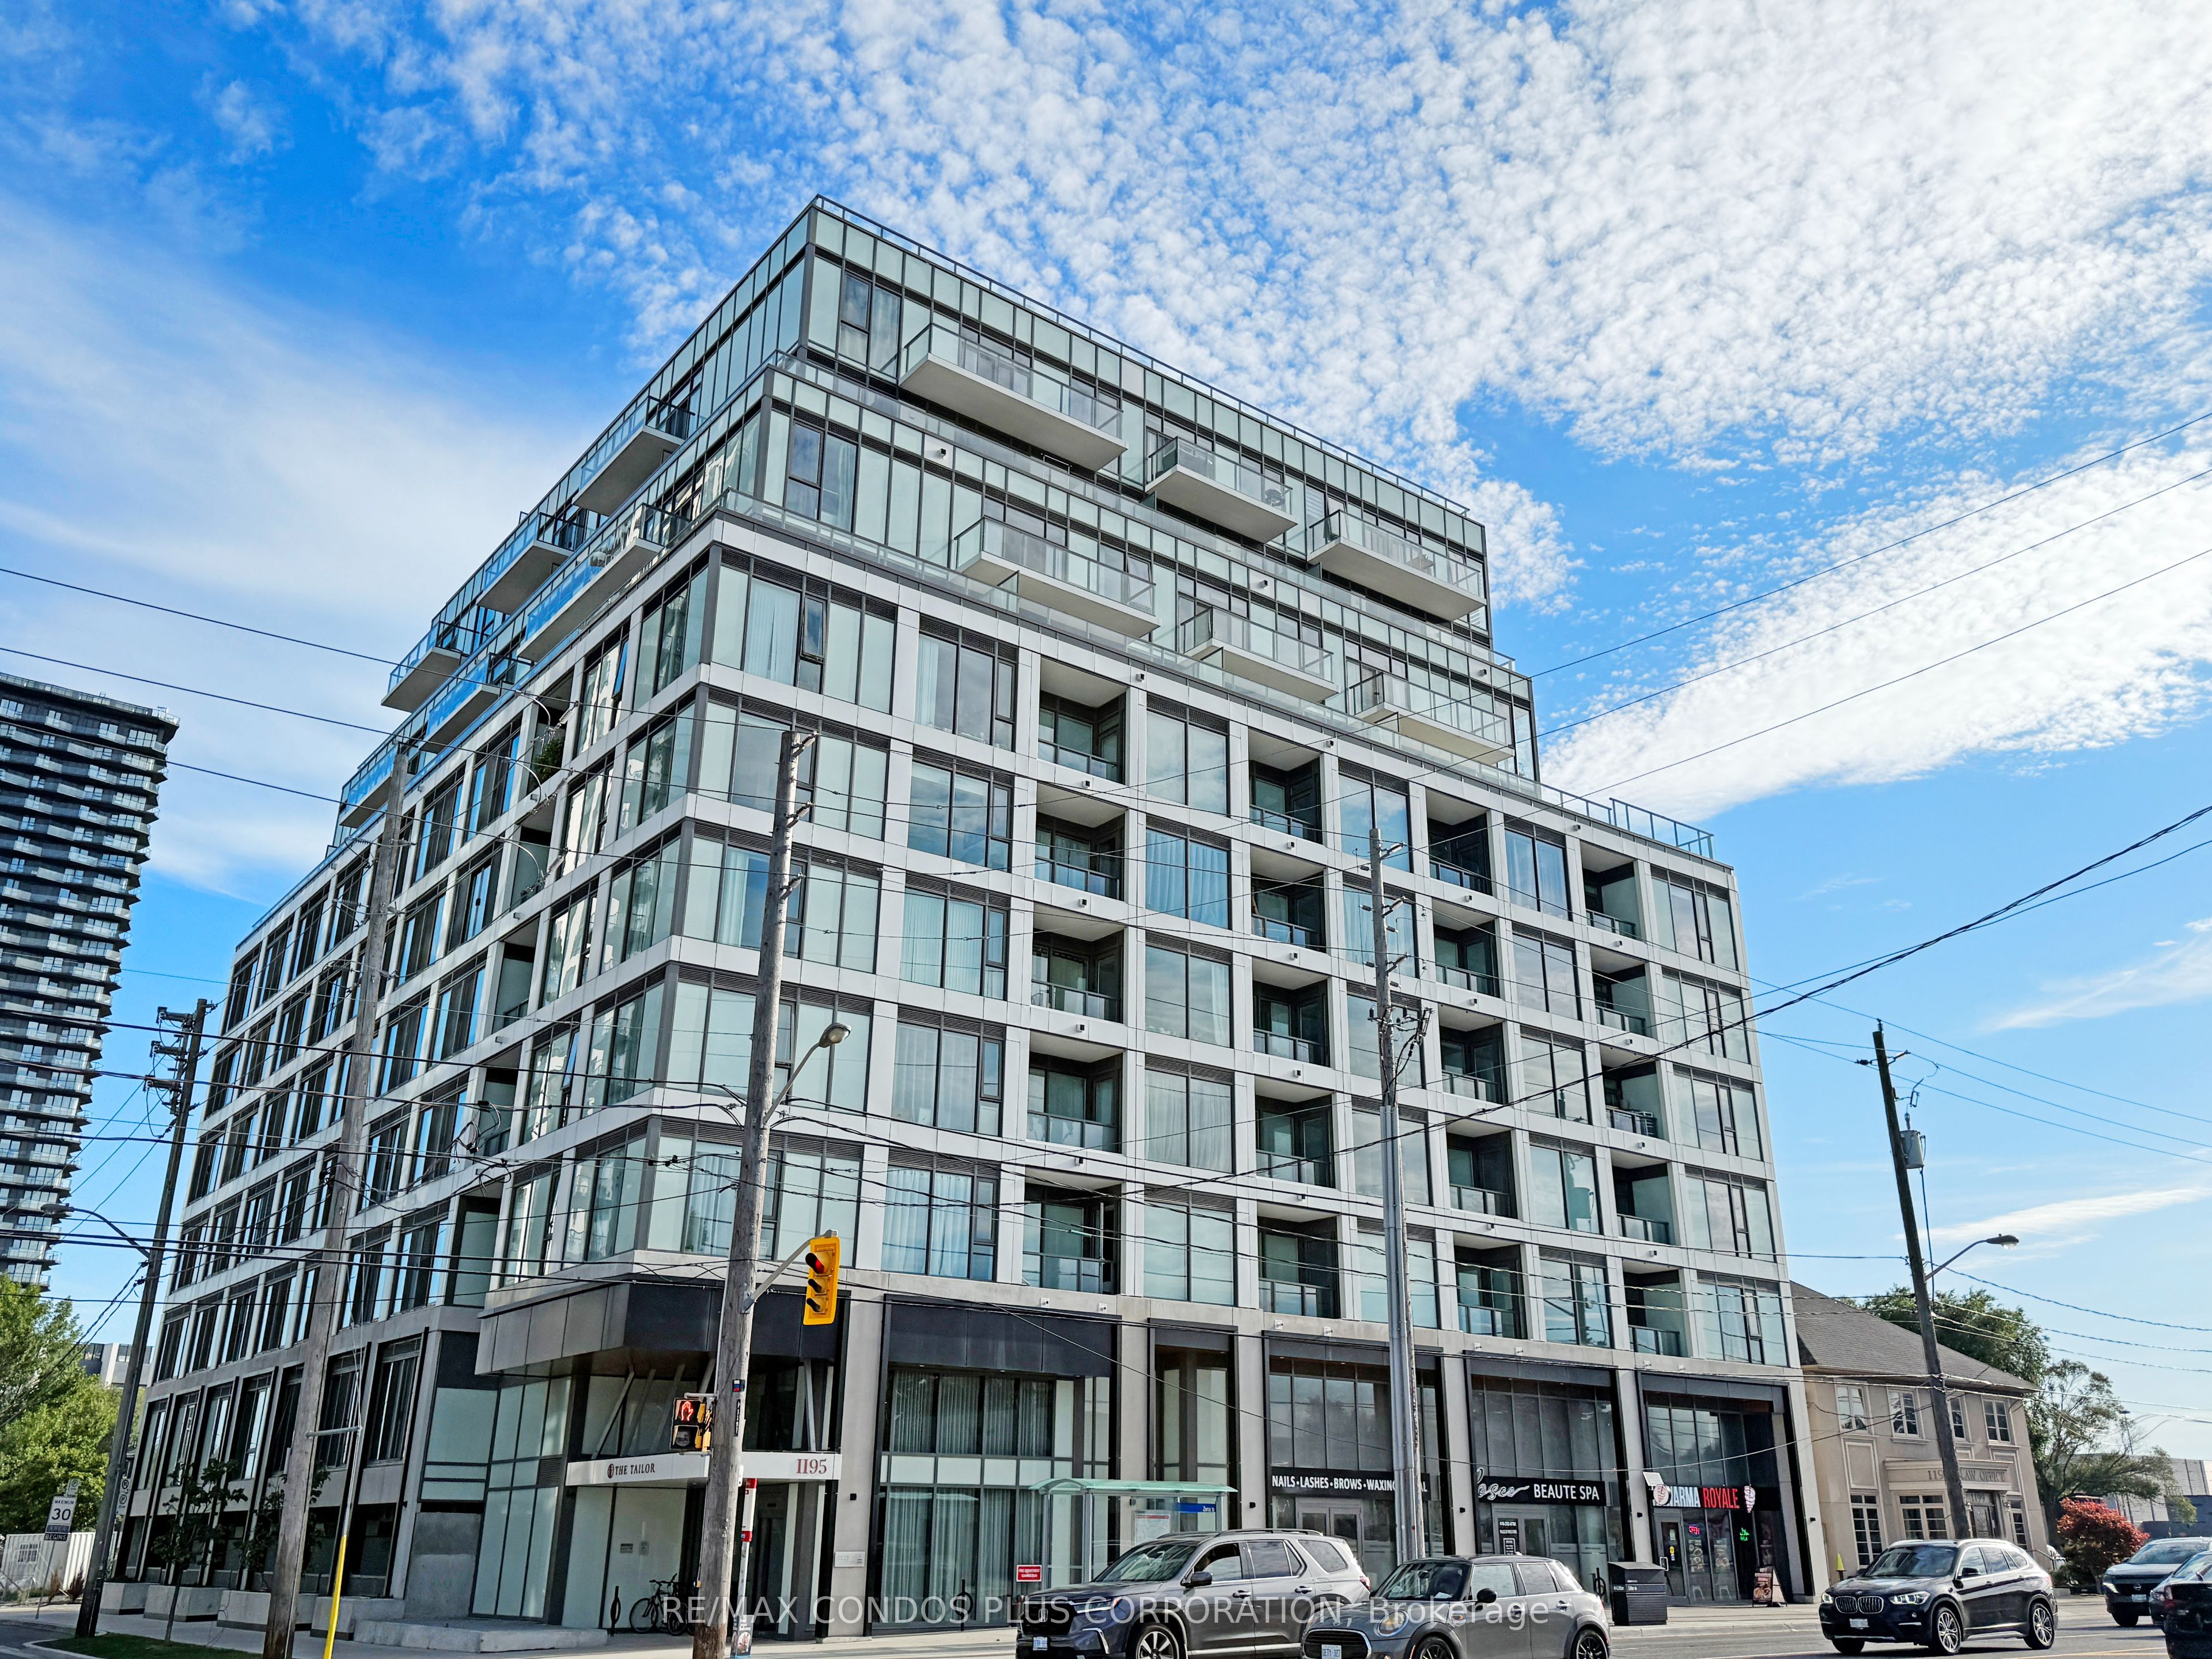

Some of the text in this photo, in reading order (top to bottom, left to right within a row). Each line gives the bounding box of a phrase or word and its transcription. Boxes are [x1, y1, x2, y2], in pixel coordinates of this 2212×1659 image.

[615, 1463, 655, 1475] THE TAILOR
[797, 1459, 827, 1474] 1195
[1272, 1475, 1296, 1487] NAILS
[1300, 1476, 1329, 1488] LASHES
[1334, 1478, 1362, 1490] BROWS
[1927, 1470, 1944, 1480] 119
[1533, 1484, 1577, 1499] BEAUTE
[1580, 1486, 1600, 1501] SPA
[1703, 1487, 1740, 1509] ROYALE
[51, 1508, 71, 1521] 30
